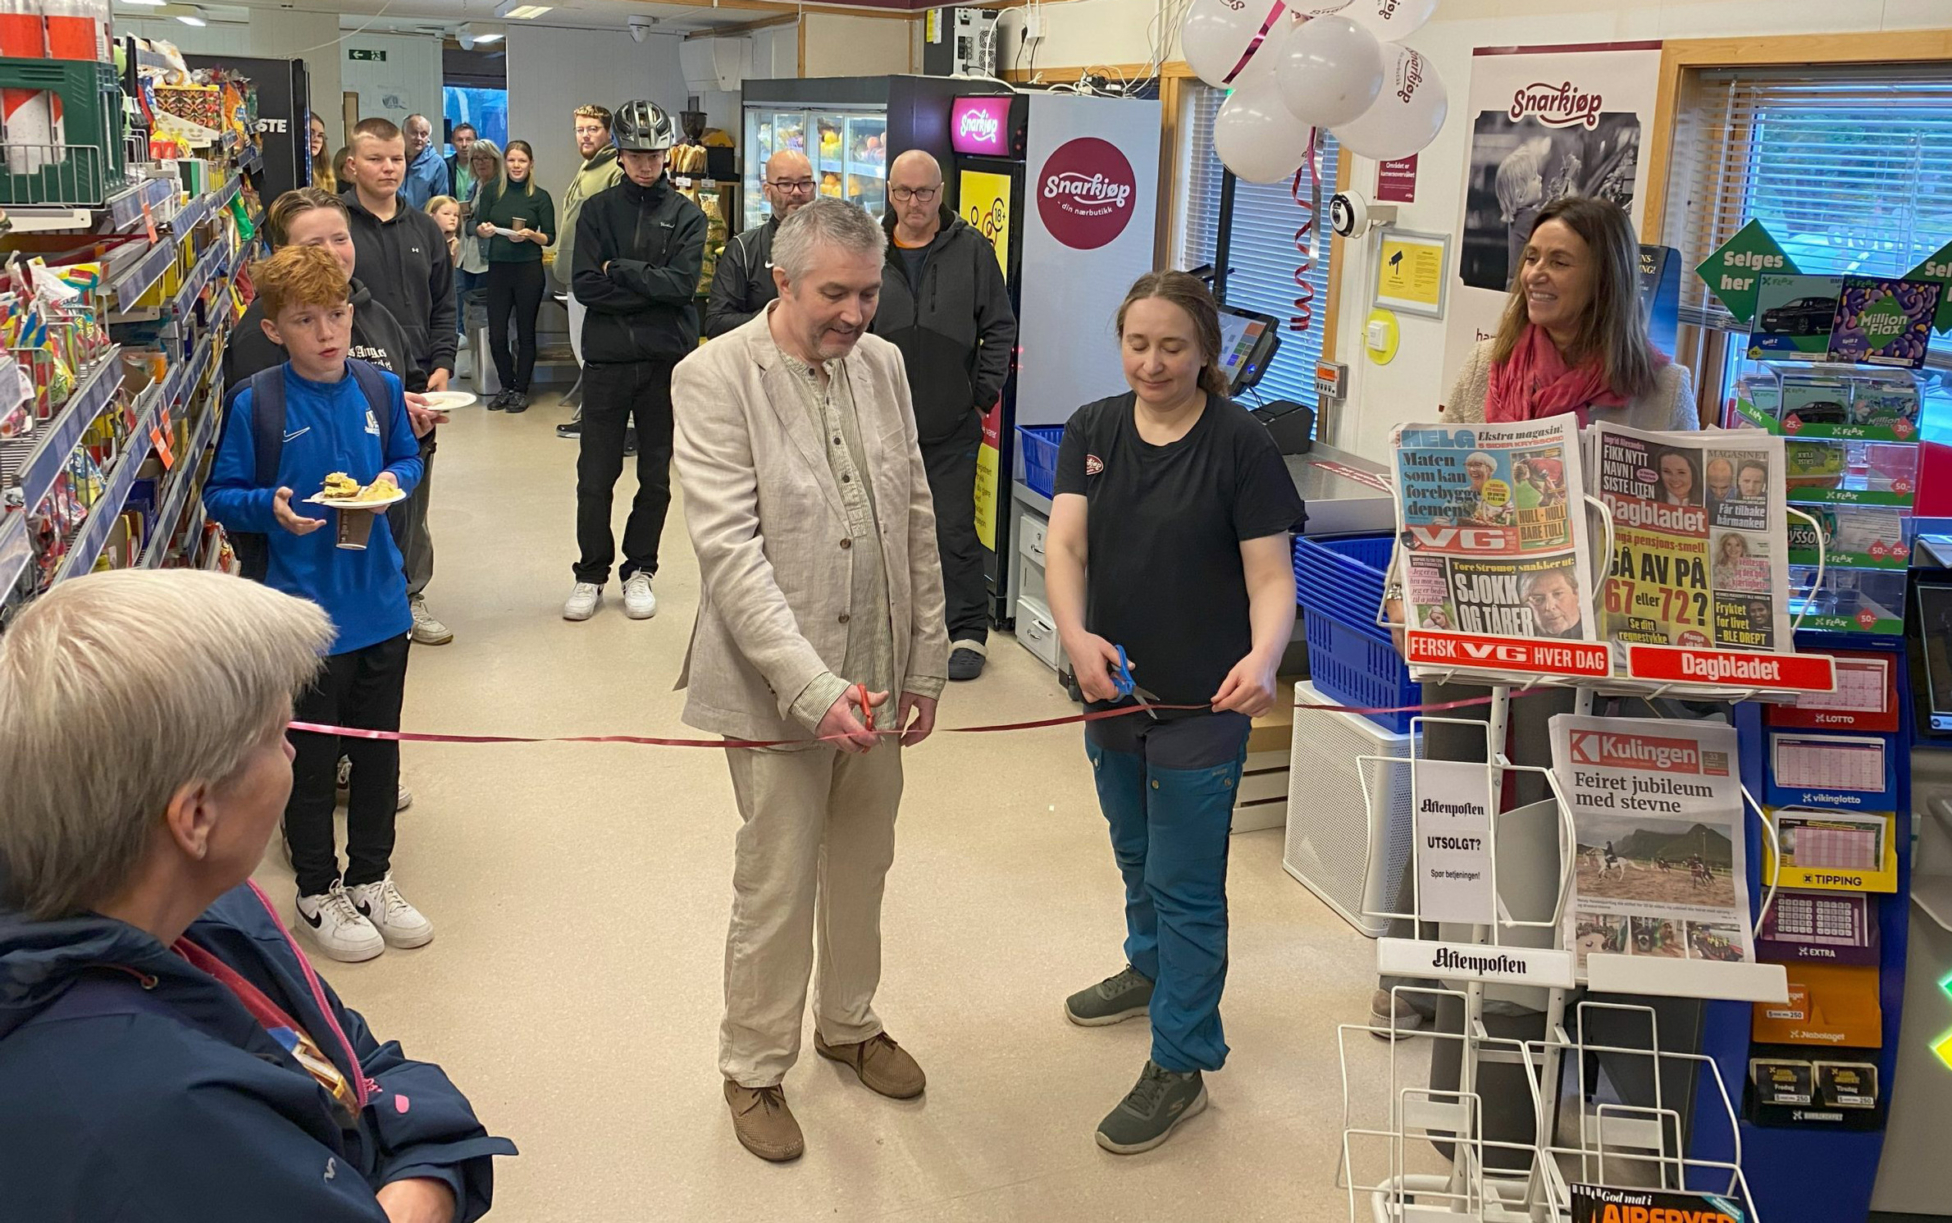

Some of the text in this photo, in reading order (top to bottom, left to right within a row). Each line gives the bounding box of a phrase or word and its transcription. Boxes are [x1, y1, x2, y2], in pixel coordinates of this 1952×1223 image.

[1510, 81, 1602, 126] Snarkjøp
[960, 109, 998, 143] Snarkjøp
[1044, 172, 1130, 208] Snarkjøp
[1061, 203, 1073, 214] din
[1074, 206, 1113, 217] nærbutikk
[1723, 251, 1784, 271] Selges
[1639, 265, 1656, 274] NG!
[1720, 274, 1753, 291] her
[1860, 313, 1908, 326] Million
[1869, 323, 1901, 336] Flax
[1786, 420, 1802, 429] 25,-
[1842, 427, 1865, 436] FLAX
[1478, 424, 1563, 442] Ekstra magasin!
[1515, 436, 1564, 447] KRYSSORD
[1403, 452, 1455, 467] Maten
[1604, 445, 1648, 468] FIKK NYTT
[1709, 450, 1769, 460] MAGASINET
[1404, 469, 1466, 483] som kan
[1603, 460, 1629, 478] NAVN
[1630, 464, 1634, 479] I
[1603, 475, 1628, 495] SISTE
[1630, 481, 1655, 499] LITEN
[1896, 482, 1911, 490] 50,-
[1405, 484, 1481, 504] forebygge
[1836, 493, 1859, 501] FLAX
[1408, 501, 1471, 518] demens
[1519, 509, 1539, 523] NULL
[1545, 506, 1565, 521] NULL
[1602, 494, 1706, 533] Dagbladet
[1719, 503, 1765, 517] Får tilbake
[1410, 526, 1505, 549] VG
[1521, 525, 1542, 540] BARE
[1544, 523, 1563, 537] TULL
[1634, 535, 1705, 553] pensjons-smell
[1872, 547, 1888, 555] 50,-
[1452, 561, 1475, 572] Tore
[1518, 560, 1562, 572] snakker
[1562, 557, 1575, 567] ut:
[1832, 555, 1854, 563] FLAX
[1641, 552, 1669, 585] AV
[1675, 556, 1707, 590] PÅ
[1455, 573, 1520, 605] SJOKK
[1605, 578, 1635, 615] 67
[1636, 592, 1660, 607] eller
[1715, 601, 1747, 616] Fryktet
[1461, 604, 1535, 637] OG TÅRER
[1629, 617, 1655, 632] Se ditt
[1716, 616, 1749, 630] for livet
[1826, 618, 1848, 627] FLAX
[1861, 615, 1877, 623] 50,-
[1618, 631, 1668, 645] regnestykke
[1723, 630, 1738, 642] BLE
[1739, 632, 1766, 646] DREPT
[1410, 637, 1605, 670] FERSK VG HVER DAG
[1681, 653, 1781, 681] Dagbladet
[1826, 715, 1854, 724] LOTTO
[1602, 735, 1696, 768] Kulingen
[1574, 771, 1714, 798] Feiret jubileum
[1576, 790, 1681, 813] med stevne
[1813, 793, 1861, 805] vikinglotto
[1420, 798, 1485, 818] Aftenposten
[1427, 836, 1481, 851] UTSOLGT?
[1446, 869, 1480, 881] betjeningen!
[1815, 874, 1862, 886] TIPPING
[1810, 948, 1836, 958] EXTRA
[1432, 947, 1527, 976] Aftenposten
[1801, 1031, 1845, 1042] Nabolaget
[1601, 1190, 1652, 1206] God mat i
